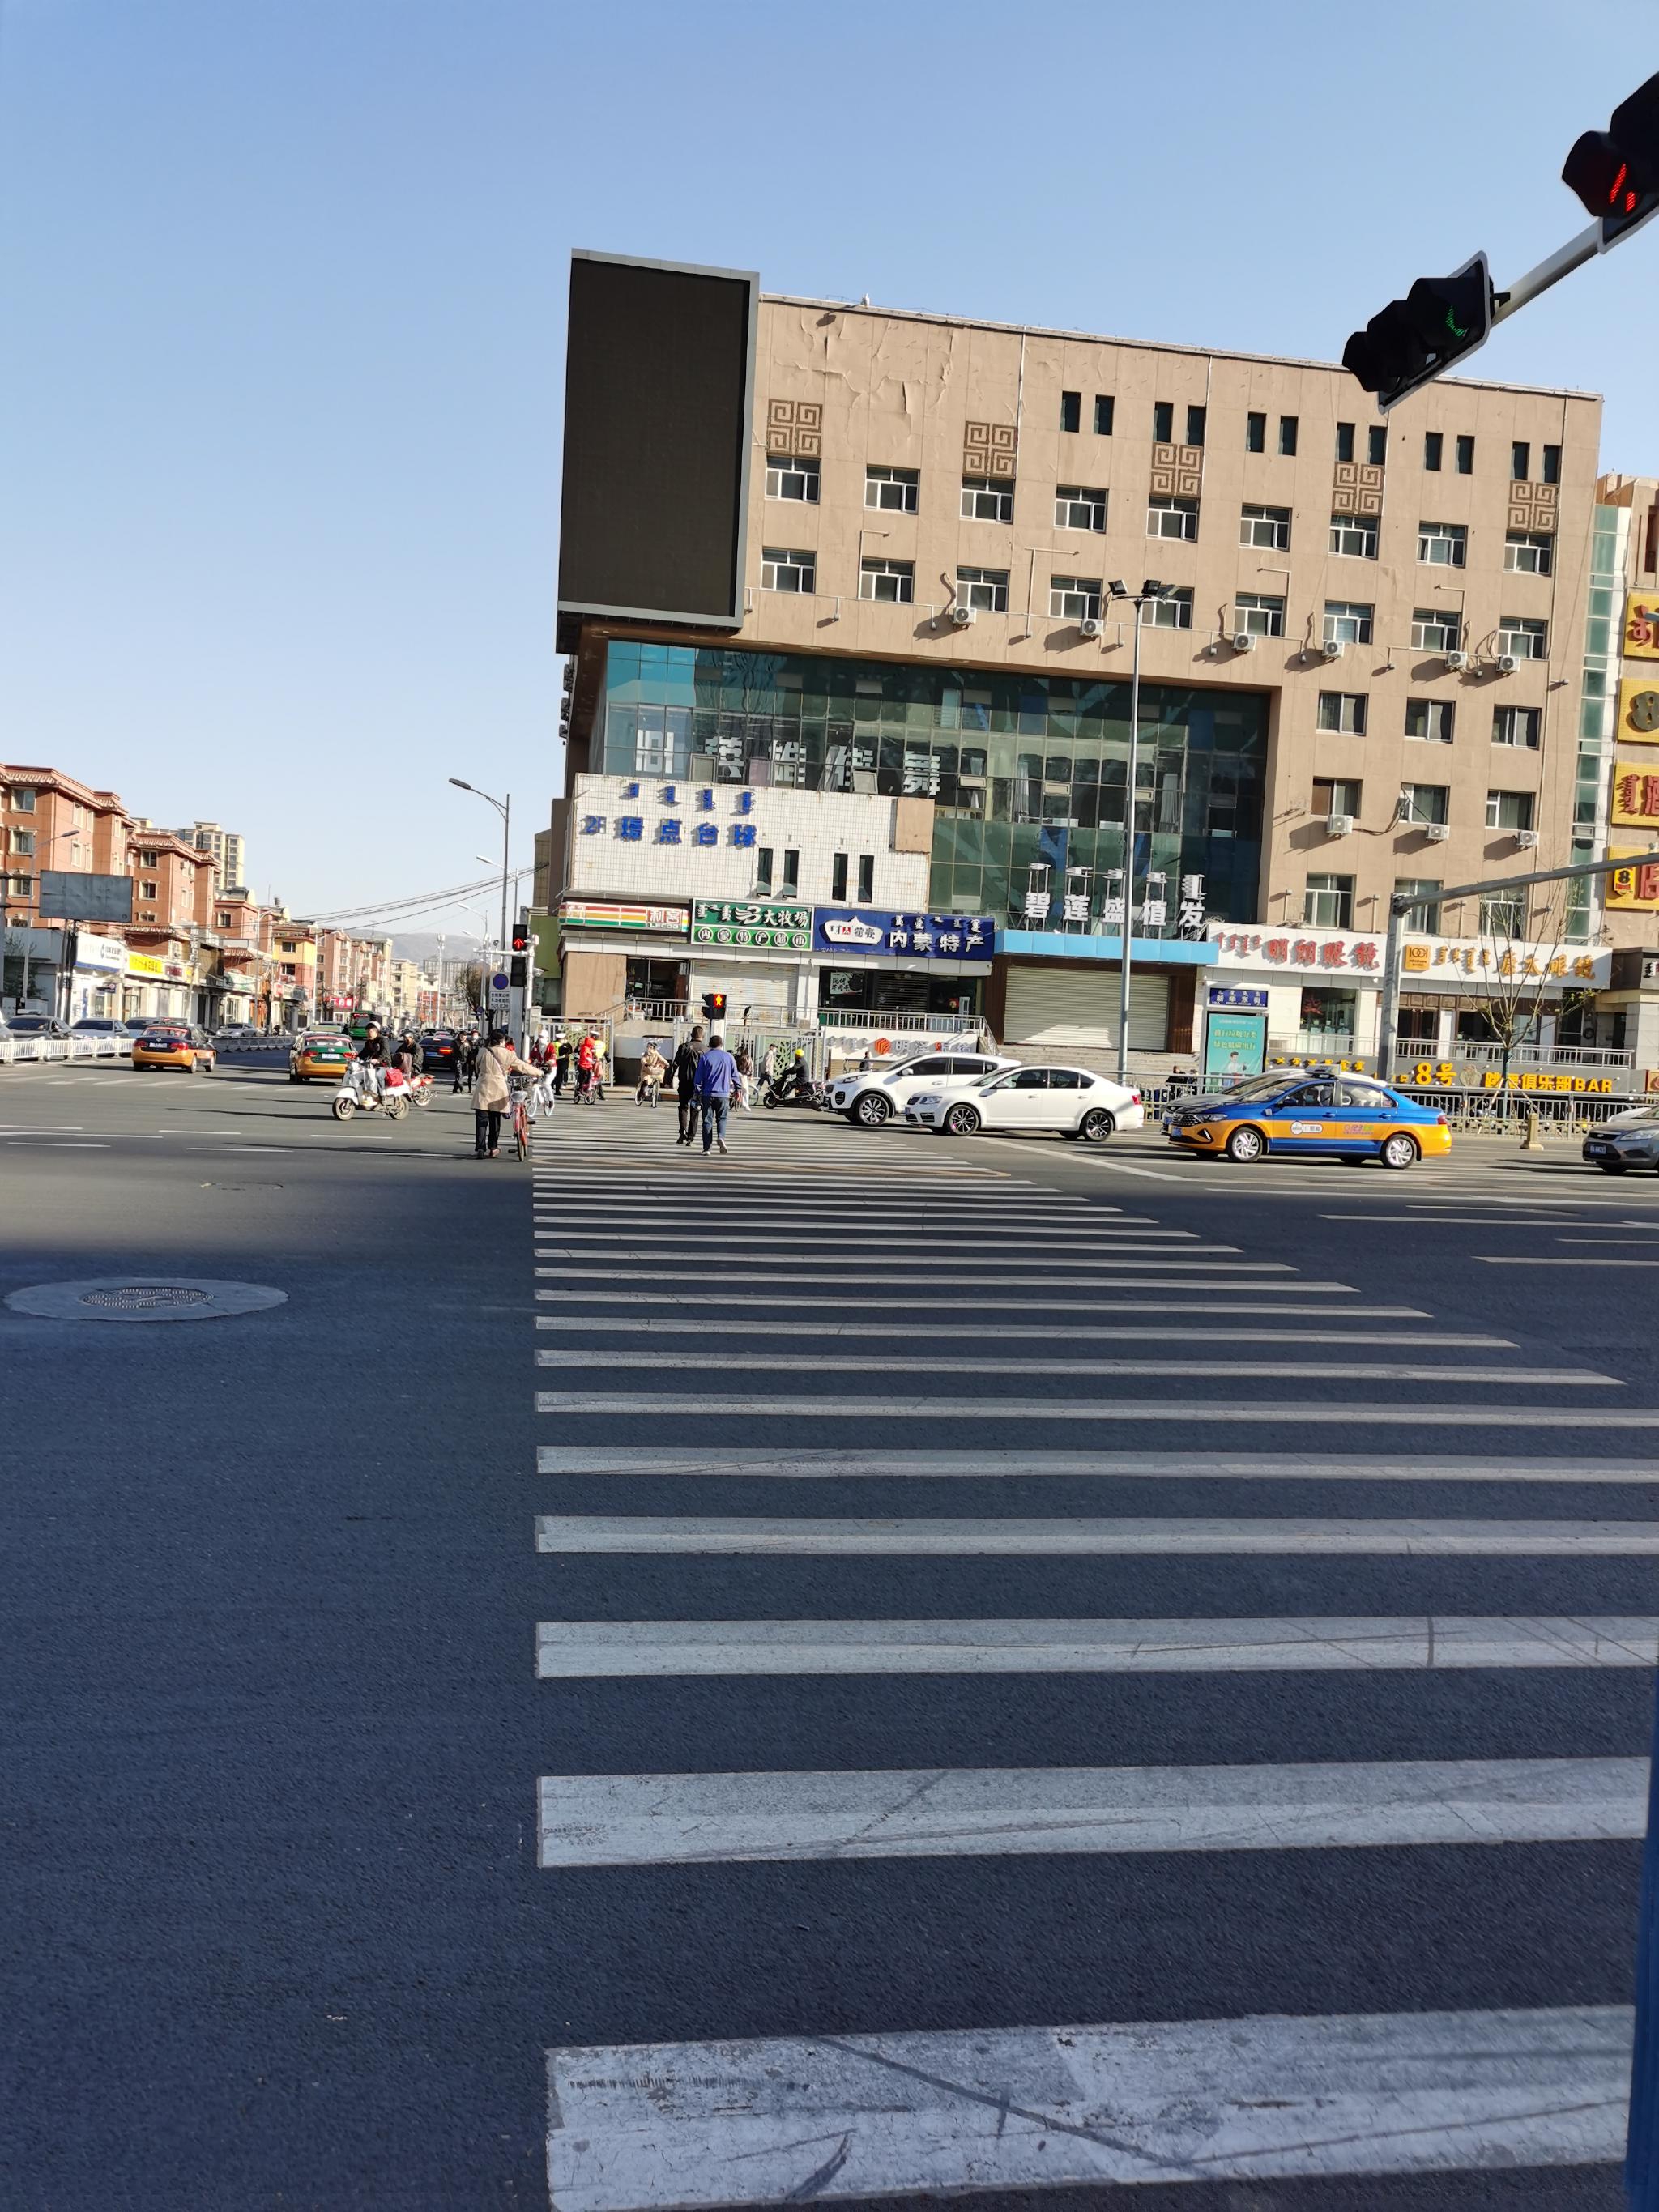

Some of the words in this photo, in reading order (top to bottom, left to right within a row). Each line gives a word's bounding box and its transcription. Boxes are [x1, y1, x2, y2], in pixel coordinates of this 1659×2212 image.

[1024, 891, 1206, 928] 碧莲盛植发
[698, 927, 809, 948] 内蒙特产超市
[889, 930, 984, 953] 内蒙特产
[1415, 1061, 1457, 1087] 8号
